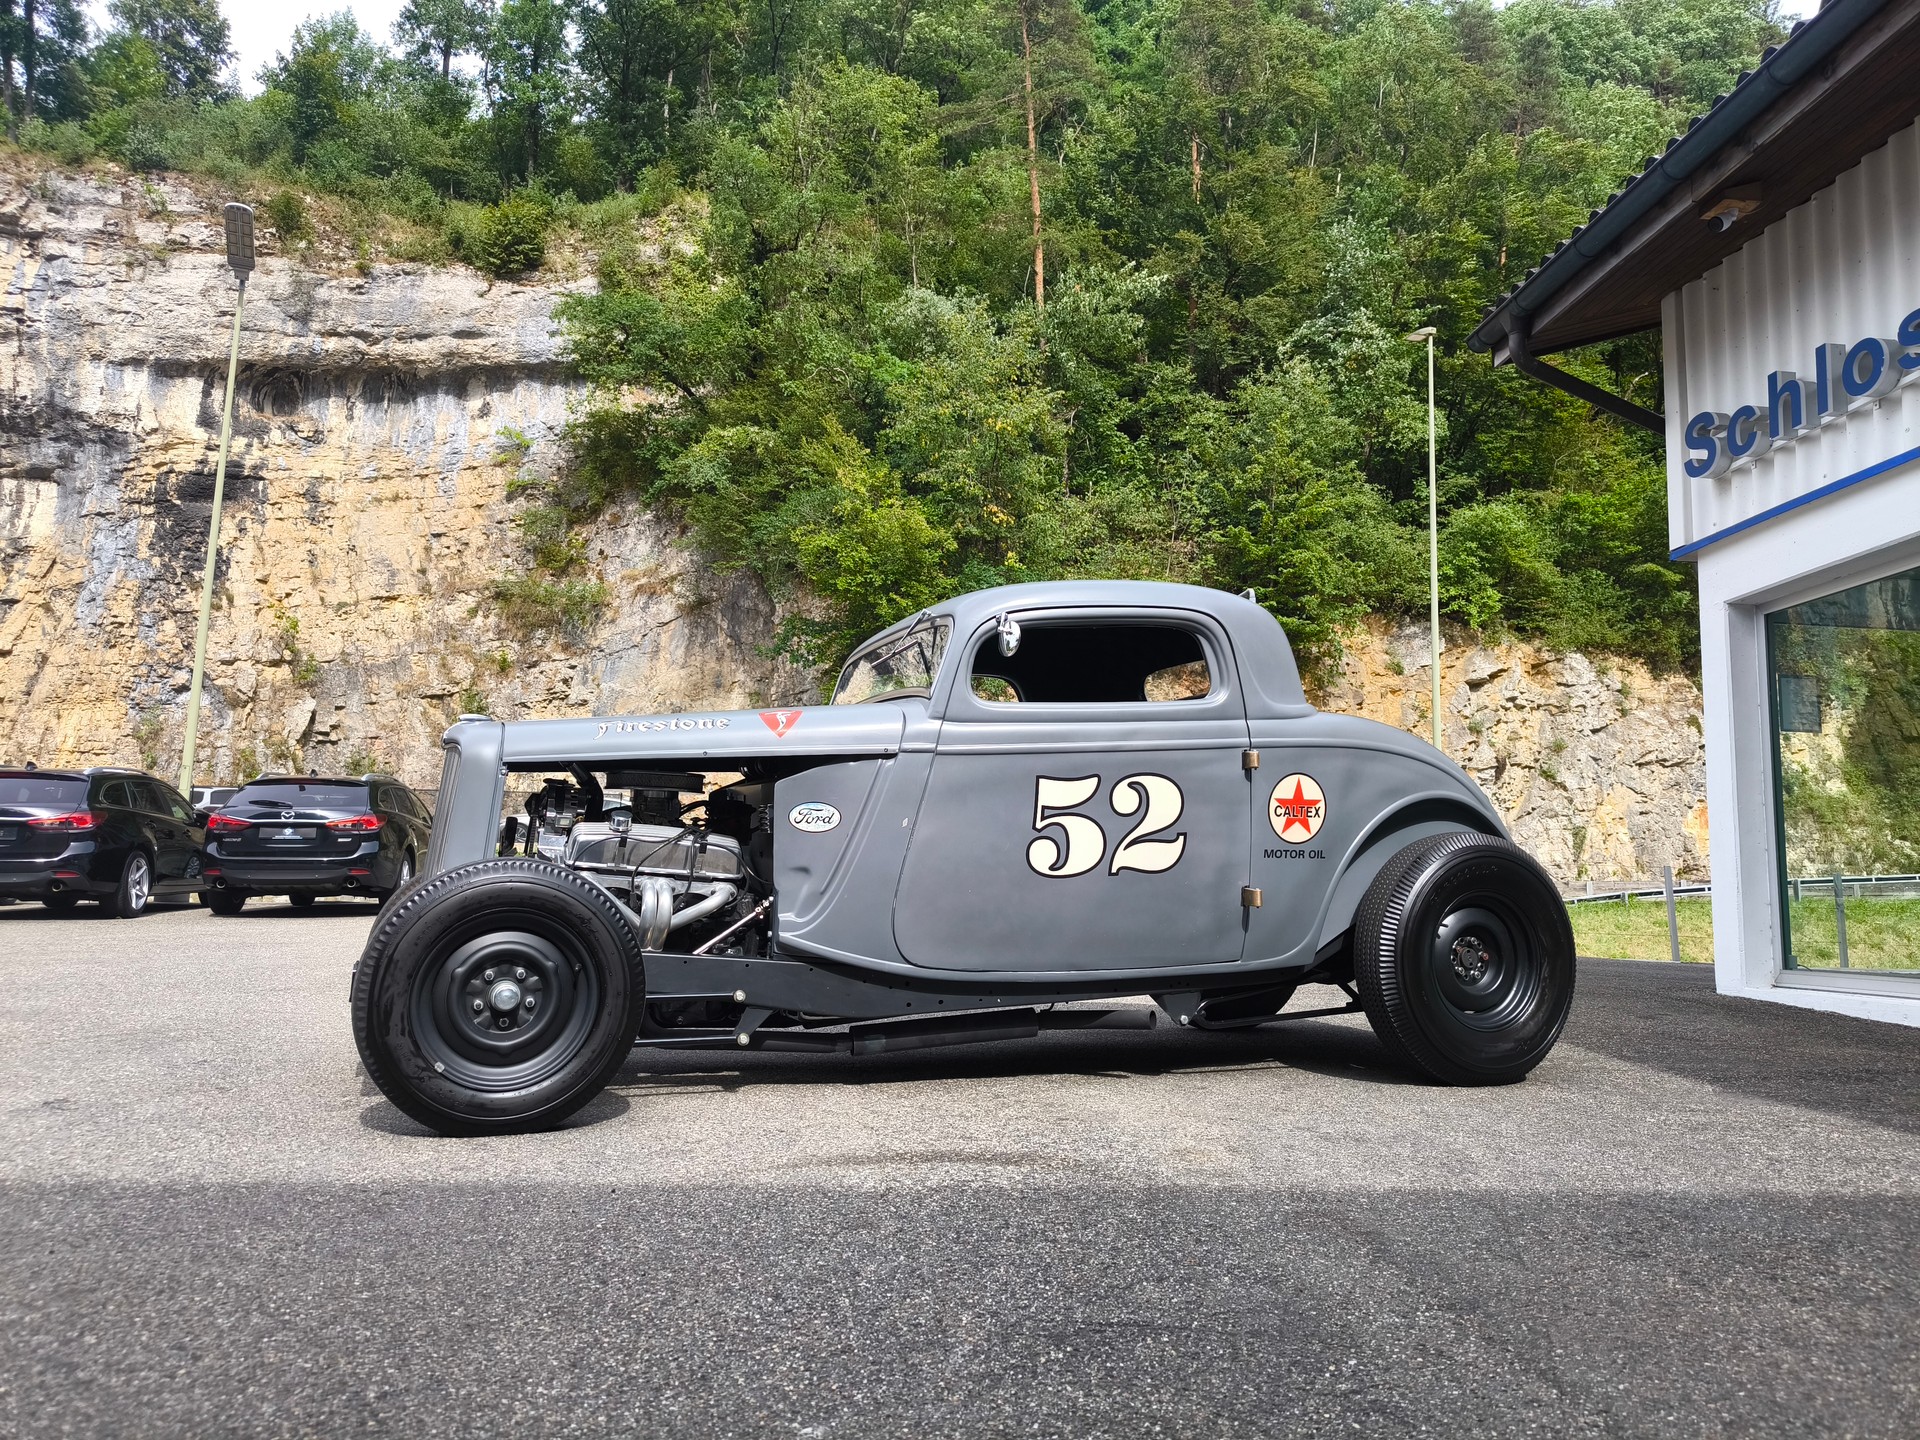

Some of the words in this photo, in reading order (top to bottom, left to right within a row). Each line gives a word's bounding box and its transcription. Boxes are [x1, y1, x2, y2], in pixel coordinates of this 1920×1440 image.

[592, 718, 731, 740] Firestone
[794, 807, 835, 824] Ford
[1274, 805, 1321, 818] CALTEX
[1025, 772, 1187, 879] 52
[1263, 849, 1305, 859] MOTOR
[1308, 849, 1326, 859] OIL
